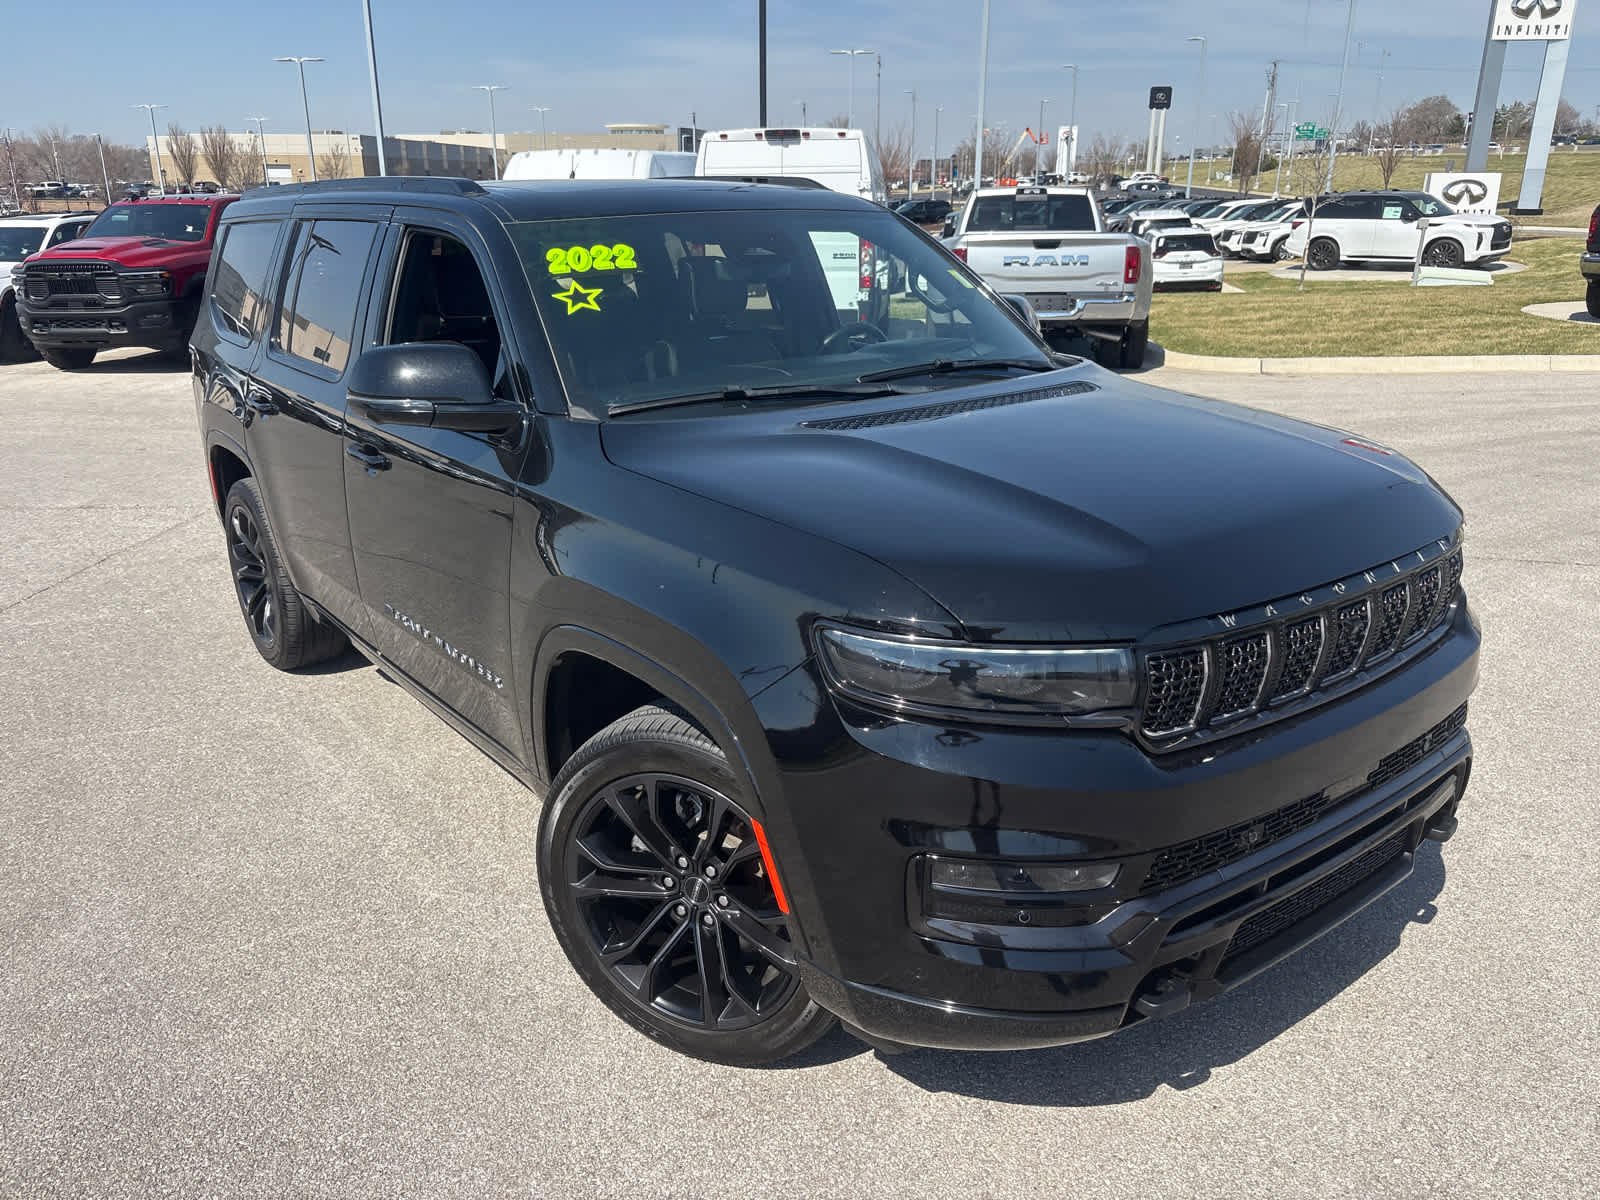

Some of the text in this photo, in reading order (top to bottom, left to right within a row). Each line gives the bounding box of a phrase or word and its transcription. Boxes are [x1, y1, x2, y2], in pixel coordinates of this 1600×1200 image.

[1496, 24, 1568, 36] INFINITI
[546, 244, 637, 274] 2022
[1003, 255, 1089, 267] RAM
